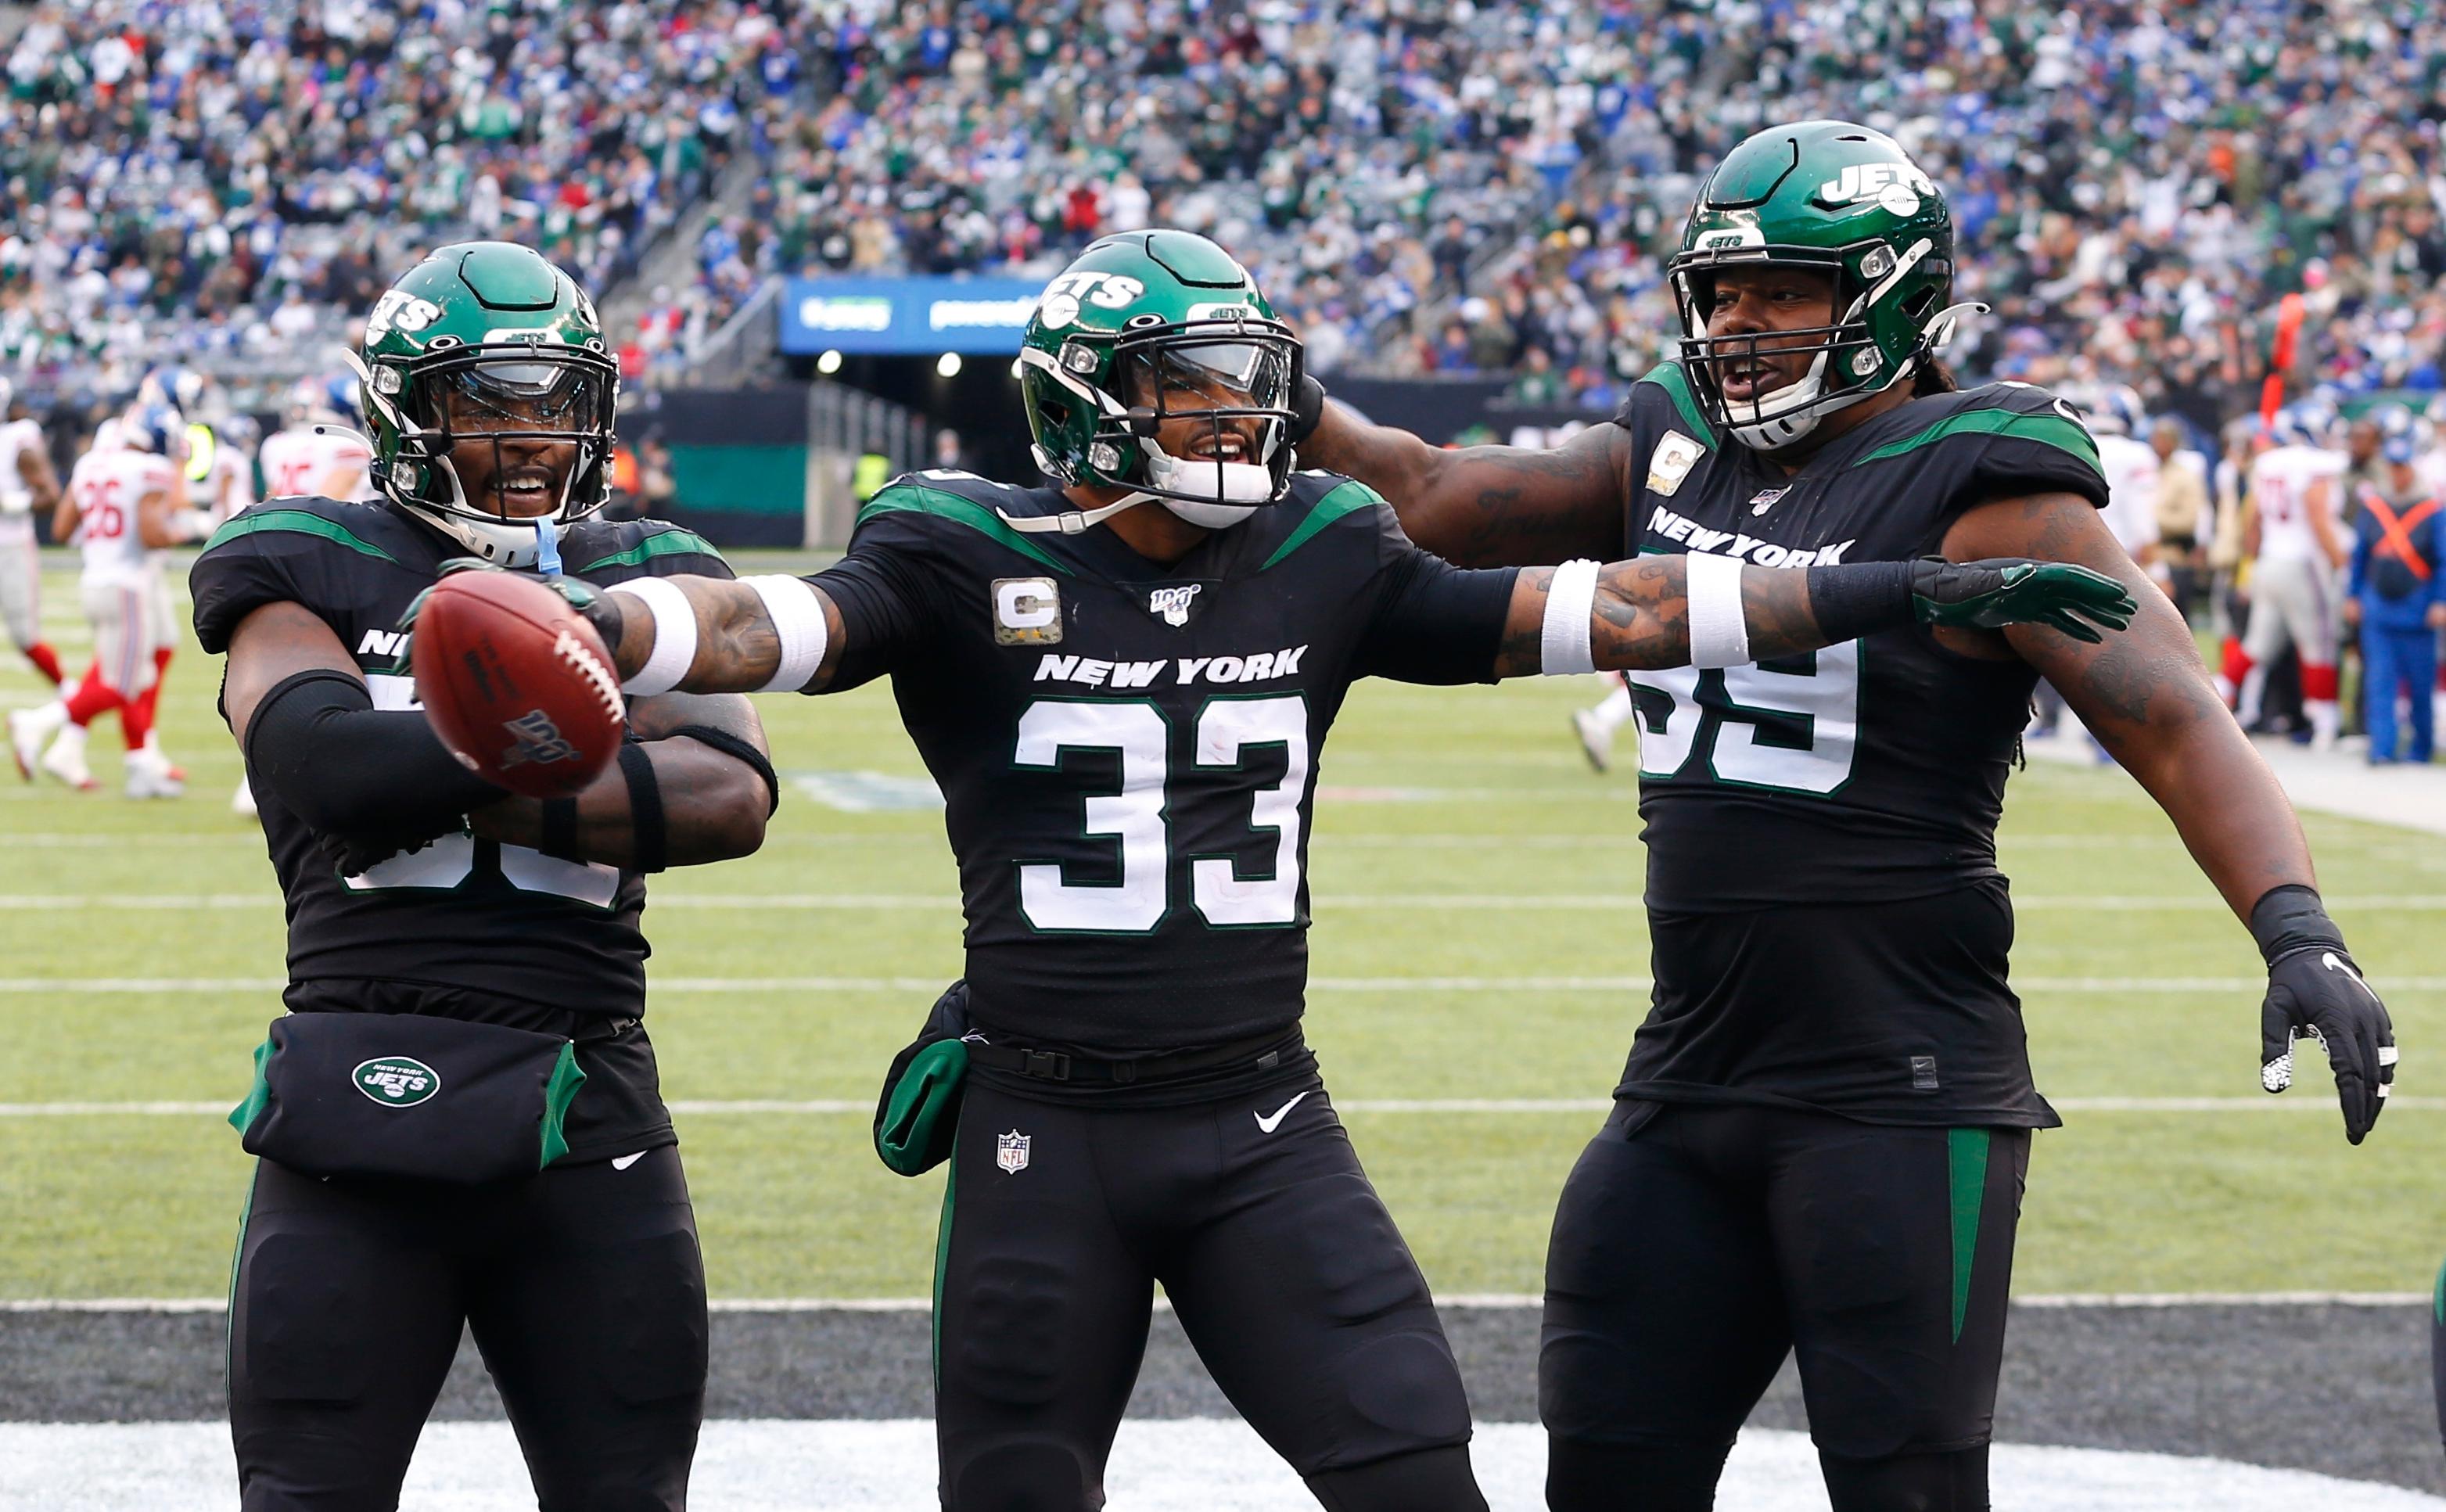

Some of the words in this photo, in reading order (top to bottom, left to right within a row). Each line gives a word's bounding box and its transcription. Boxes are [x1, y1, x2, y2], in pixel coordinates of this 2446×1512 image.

[1820, 163, 1936, 203] JETS
[1706, 235, 1744, 248] JETS
[1043, 271, 1145, 310] ETS
[1209, 307, 1248, 319] JETS
[1648, 434, 1698, 481] C
[1646, 505, 1735, 552] NEW
[1726, 533, 1856, 569] YORK
[997, 582, 1056, 629] C
[1033, 654, 1169, 689] NEW
[1176, 645, 1309, 685] YORK
[1011, 691, 1310, 934] 33
[363, 1072, 429, 1092] JETS
[372, 1064, 397, 1072] NEW
[397, 1065, 426, 1076] YORK
[1002, 1150, 1023, 1165] NFL
